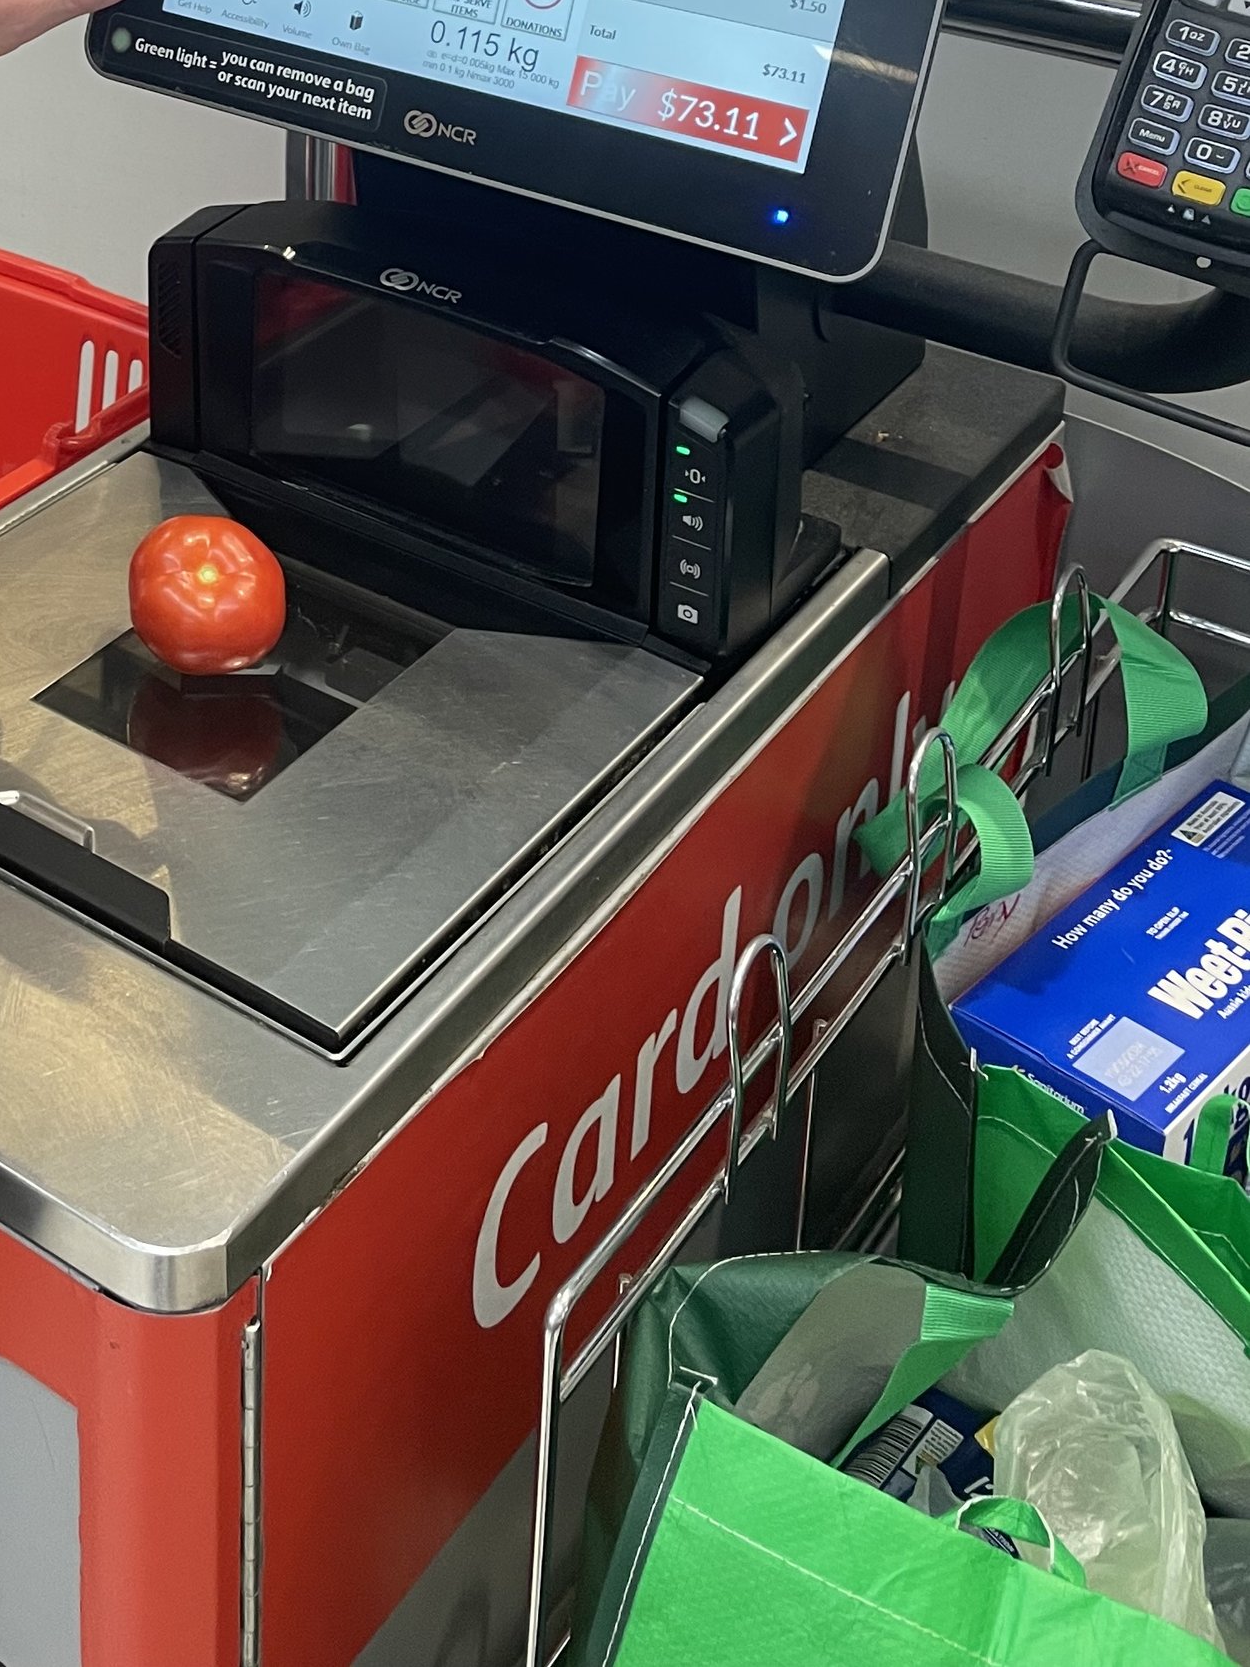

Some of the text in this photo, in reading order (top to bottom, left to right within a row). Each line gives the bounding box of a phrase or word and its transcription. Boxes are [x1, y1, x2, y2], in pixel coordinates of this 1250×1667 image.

[194, 2, 212, 14] Help
[451, 4, 479, 18] ITEMS
[221, 9, 269, 29] Accessibility
[506, 17, 563, 37] DONATIONS
[282, 24, 312, 39] Volume
[589, 24, 617, 40] Total
[135, 37, 174, 61] Green
[176, 44, 207, 69] light
[332, 37, 371, 55] Own Bag
[431, 20, 539, 72] 0.115 kg
[221, 50, 375, 104] you can remove a bag
[762, 63, 806, 84] $73.11
[217, 70, 372, 121] or scan your next item
[580, 70, 760, 141] Pay $73.11
[435, 121, 477, 146] NCR
[1139, 128, 1166, 142] Menu
[417, 281, 462, 304] NCR
[1052, 924, 1087, 949] How
[1082, 899, 1120, 927] many
[1111, 887, 1133, 901] do
[1127, 869, 1154, 890] you
[1217, 997, 1244, 1019] Aussie
[1159, 1073, 1186, 1093] 1.2kg
[472, 883, 742, 1329] Card
